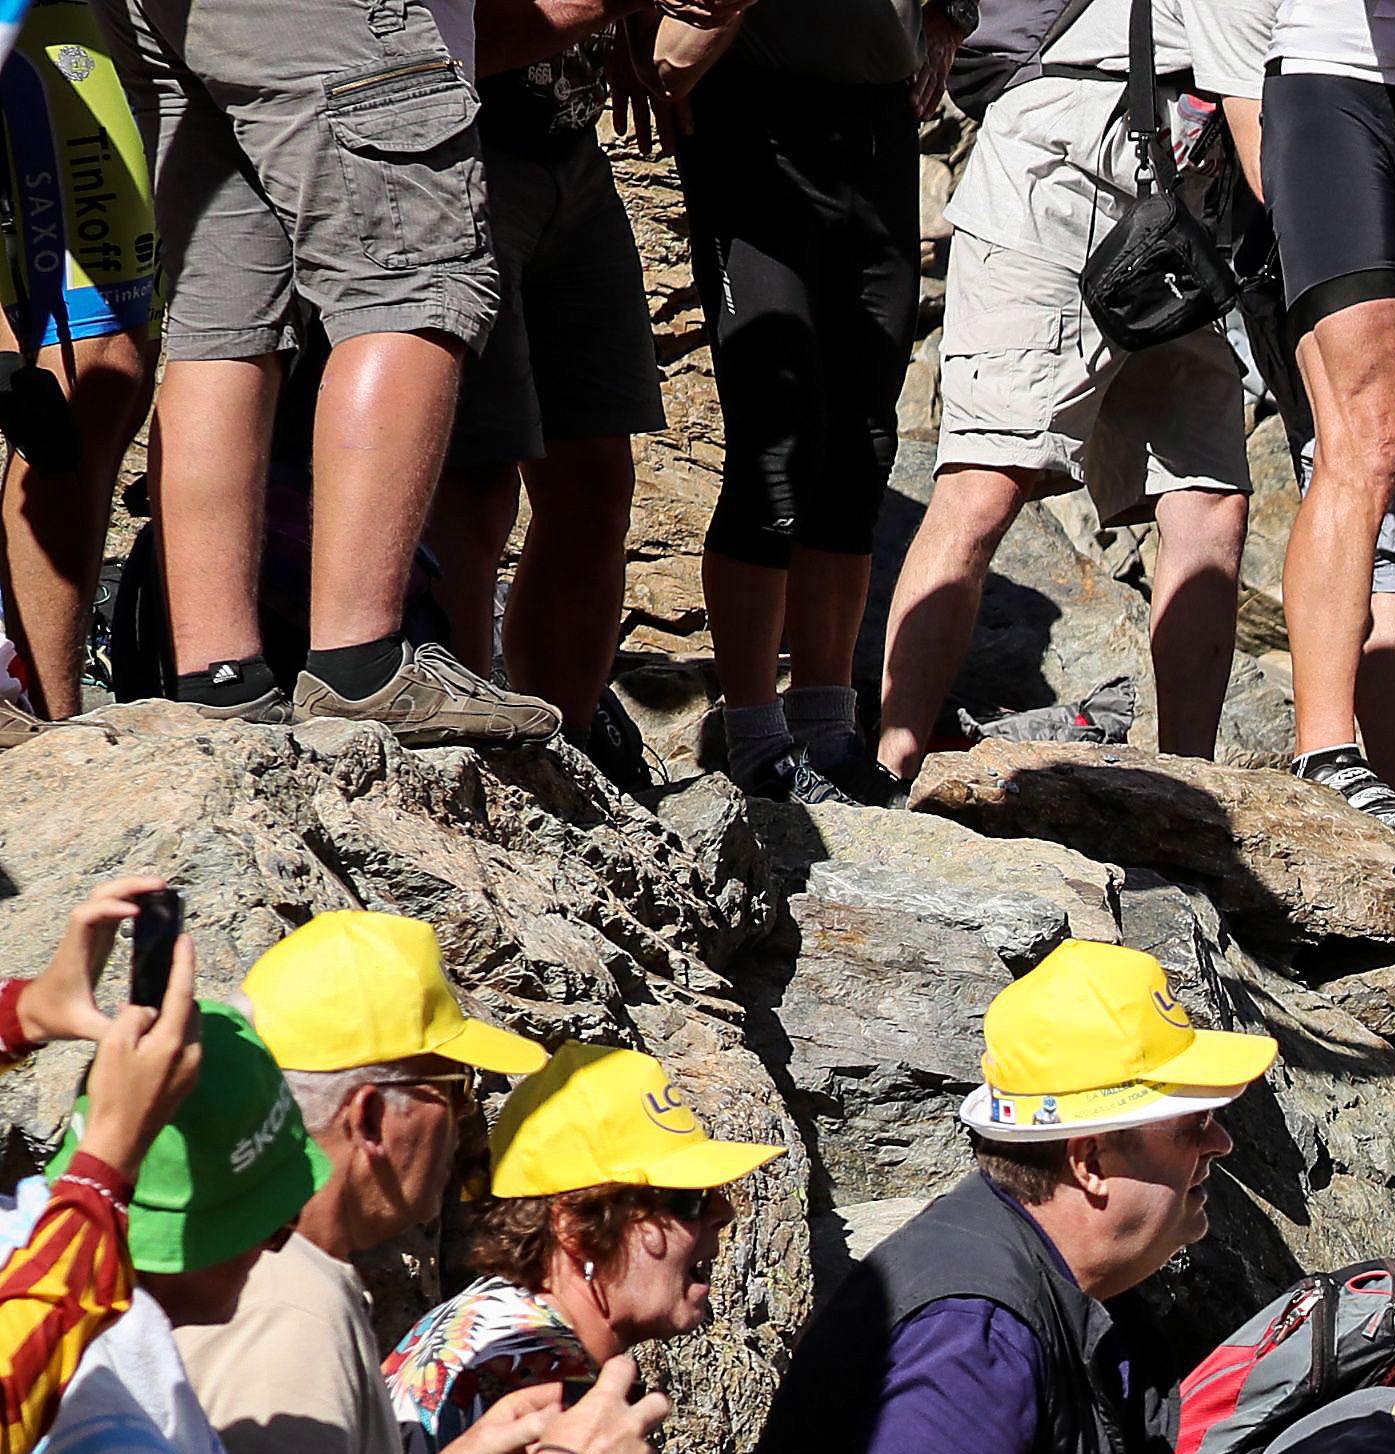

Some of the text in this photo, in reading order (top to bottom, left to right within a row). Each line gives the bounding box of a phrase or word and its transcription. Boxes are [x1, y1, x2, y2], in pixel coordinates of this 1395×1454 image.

[25, 171, 59, 273] SAXO
[66, 126, 123, 272] Tinkoff
[645, 1084, 682, 1114] LC
